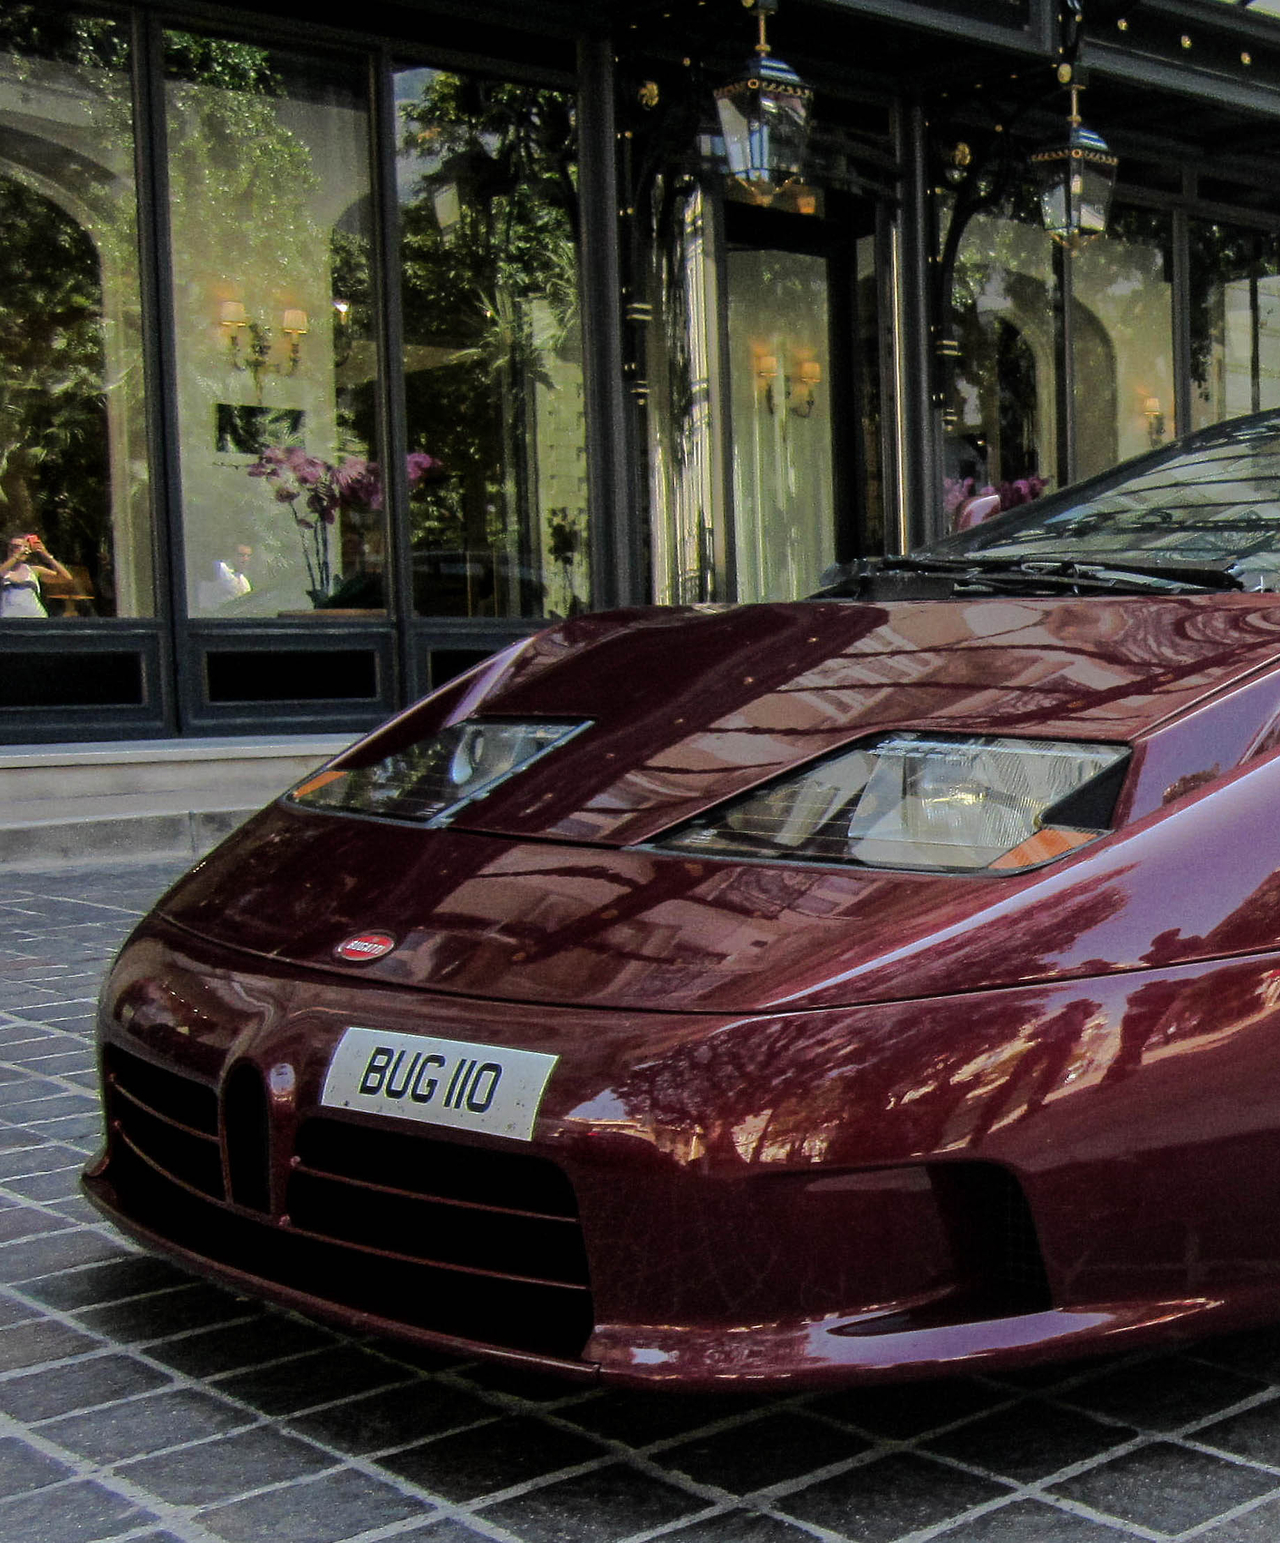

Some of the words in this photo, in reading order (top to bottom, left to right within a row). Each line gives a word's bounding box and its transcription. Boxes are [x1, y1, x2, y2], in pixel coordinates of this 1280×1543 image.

[345, 940, 386, 955] BUGATTI
[358, 1046, 446, 1104] BUG
[443, 1058, 503, 1114] 110
